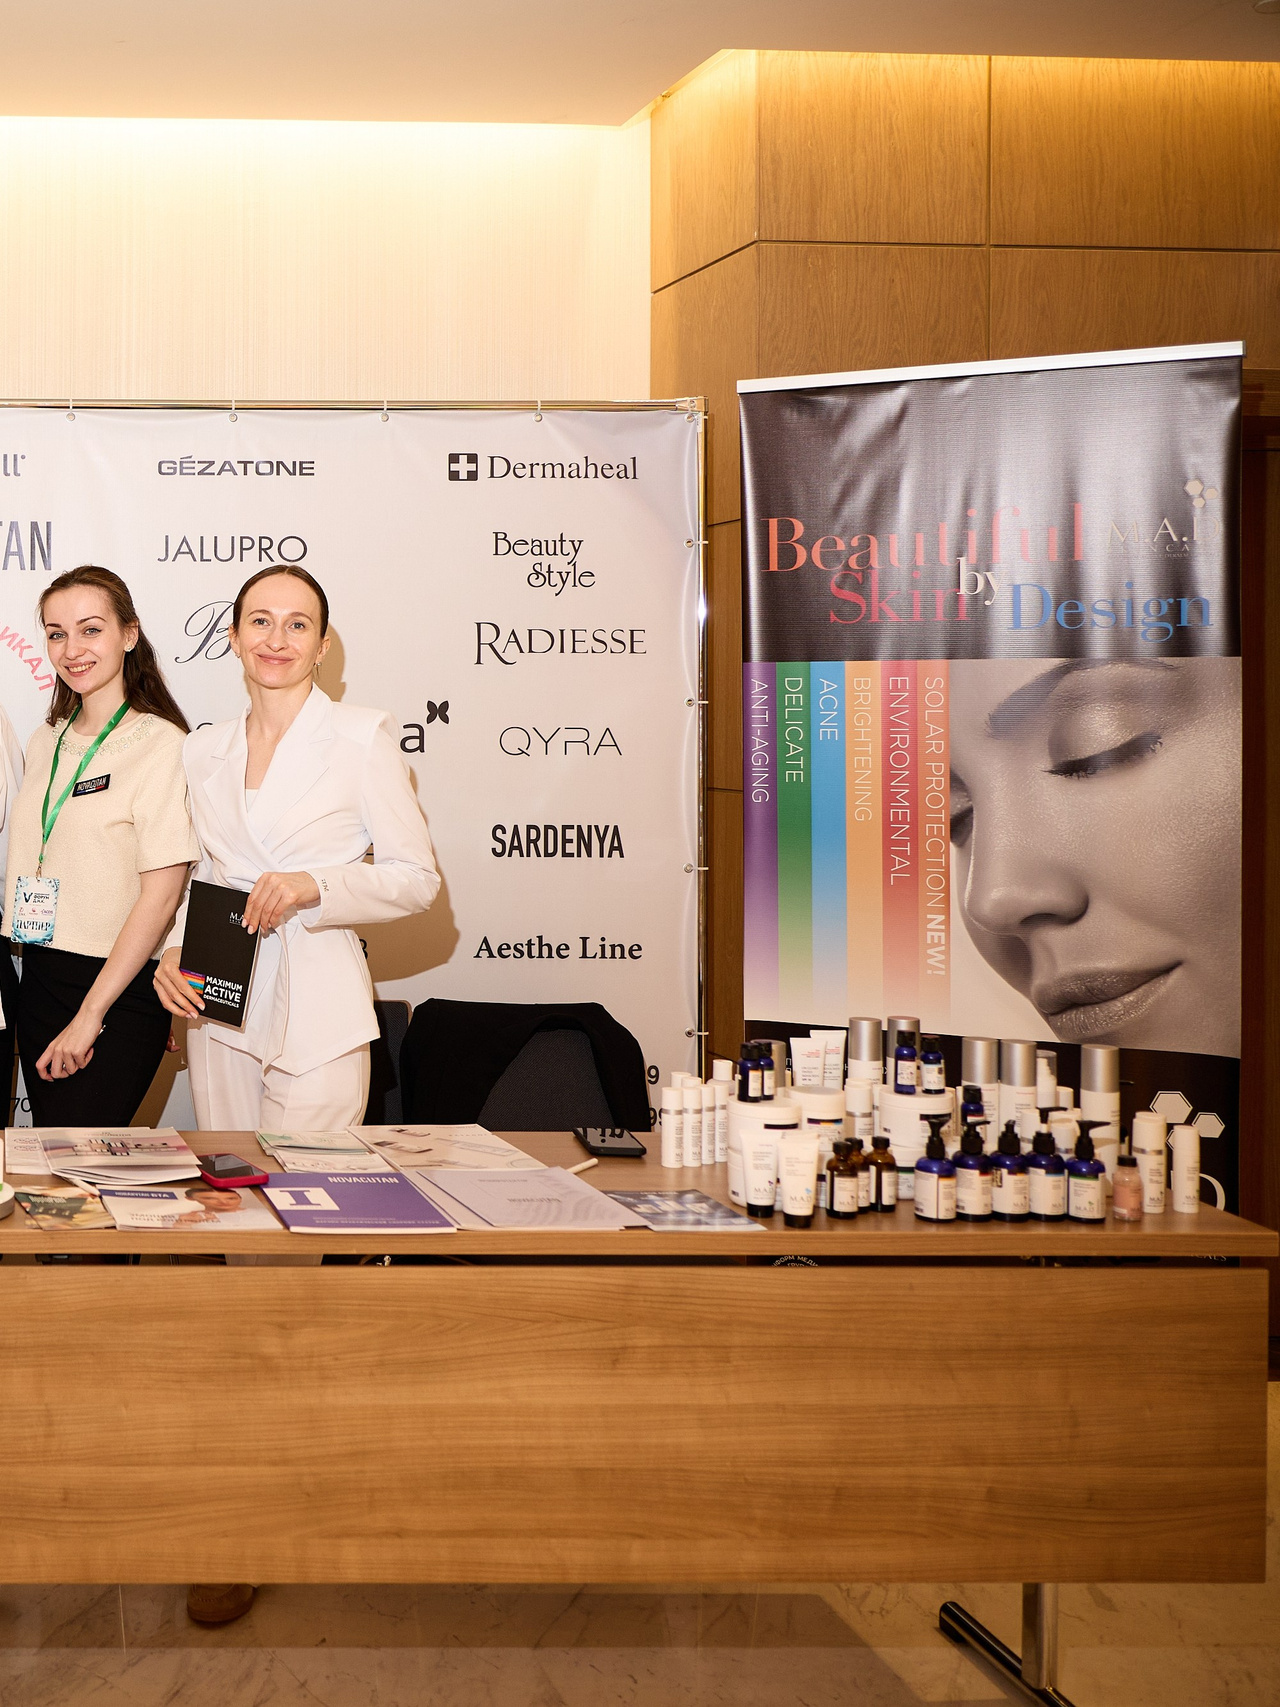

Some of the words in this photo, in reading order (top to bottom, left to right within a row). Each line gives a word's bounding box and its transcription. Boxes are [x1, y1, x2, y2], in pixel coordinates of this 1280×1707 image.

[157, 455, 316, 477] GÉZATONE
[487, 455, 639, 481] Dermaheal
[157, 535, 308, 564] JALUPRO
[492, 531, 584, 565] Beauty
[760, 502, 1084, 573] Beautiful
[527, 562, 596, 596] Style
[829, 571, 972, 626] Skin
[956, 557, 1005, 605] by
[1006, 582, 1215, 643] Design
[474, 622, 647, 665] RADIESSE
[784, 677, 804, 783] DELICATE
[819, 678, 838, 741] ACNE
[924, 676, 945, 754] SOLAR
[498, 726, 623, 757] QYRA
[751, 678, 769, 803] ANTI-AGING
[853, 677, 873, 822] BRIGHTENING
[889, 676, 911, 885] ENVIRONMENTAL
[491, 824, 625, 859] SARDENYA
[925, 762, 946, 908] PROTECTION
[473, 936, 570, 960] Aesthe
[578, 936, 643, 960] Line
[926, 914, 946, 976] NEW!
[204, 984, 242, 1003] ACTIVE
[205, 975, 243, 992] MAXIMUM
[327, 1176, 400, 1184] NOVACUTAN
